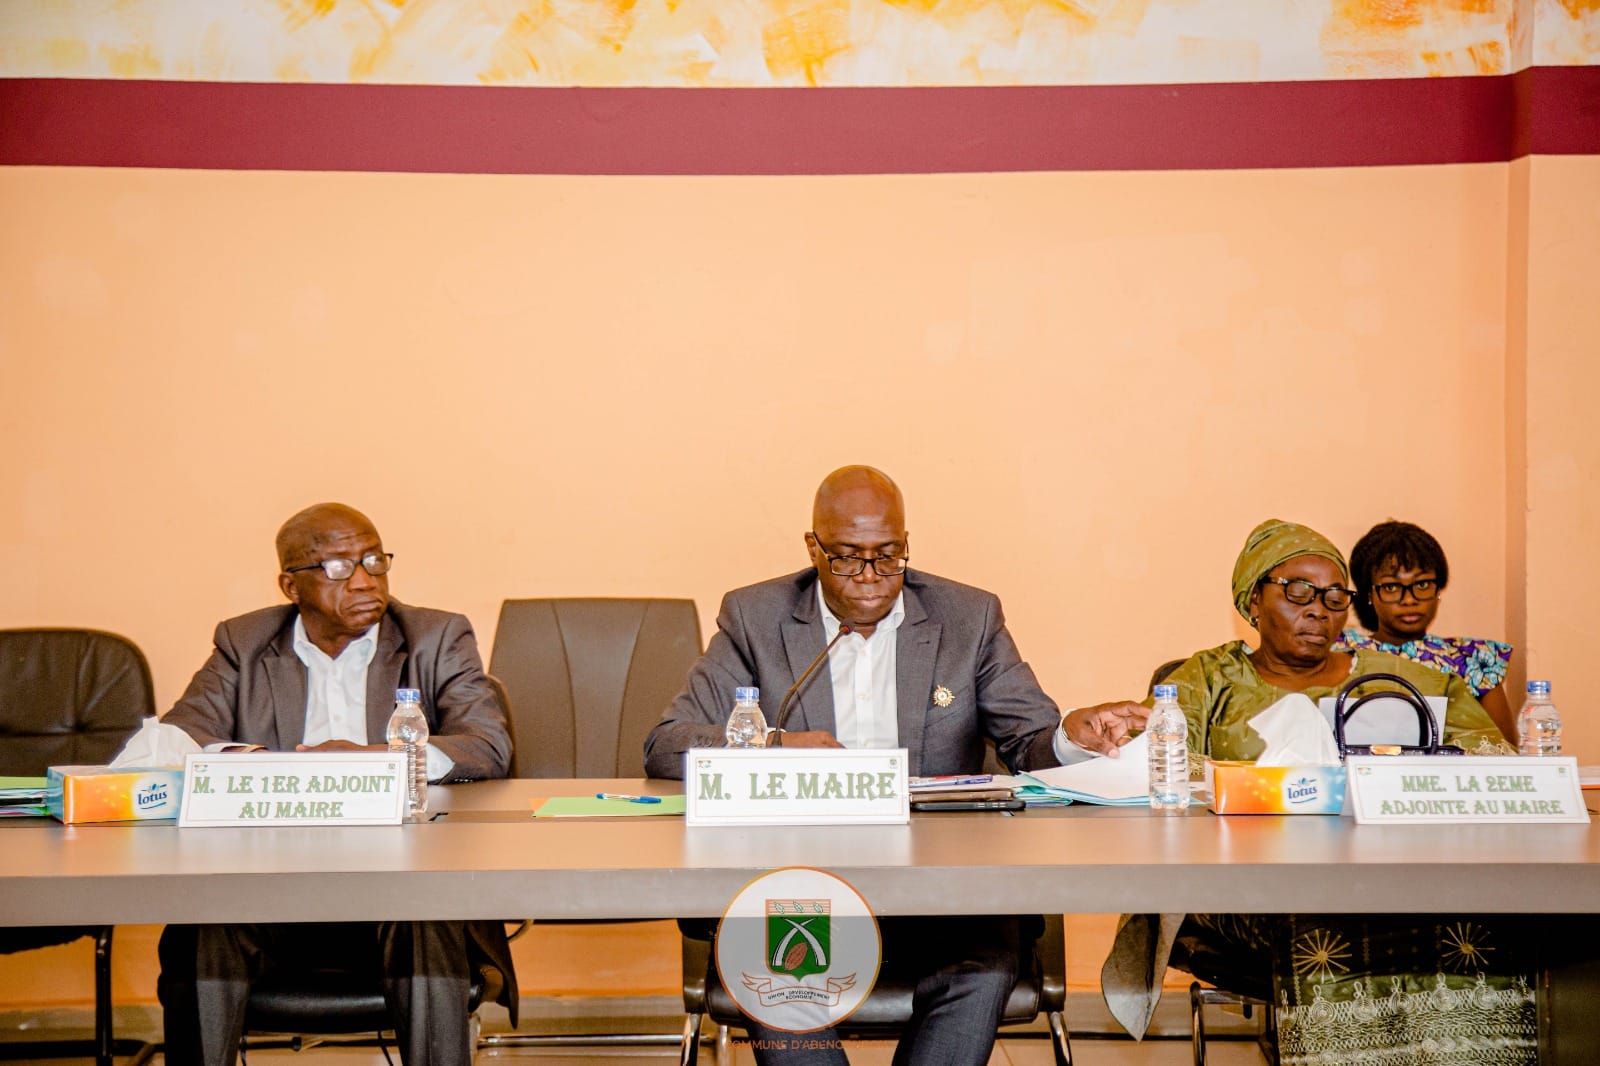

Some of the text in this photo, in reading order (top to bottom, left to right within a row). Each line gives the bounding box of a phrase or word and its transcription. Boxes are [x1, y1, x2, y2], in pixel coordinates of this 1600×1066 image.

[192, 775, 395, 795] M. LE 1ER ADJOINT
[698, 772, 897, 801] M. LE MAIRE
[1287, 786, 1318, 799] lotus
[1401, 775, 1538, 793] MME. LA 2EME
[137, 791, 168, 805] lotus
[1381, 799, 1566, 815] ADJOINTE AU MAIRE
[238, 801, 344, 819] AU MAIRE
